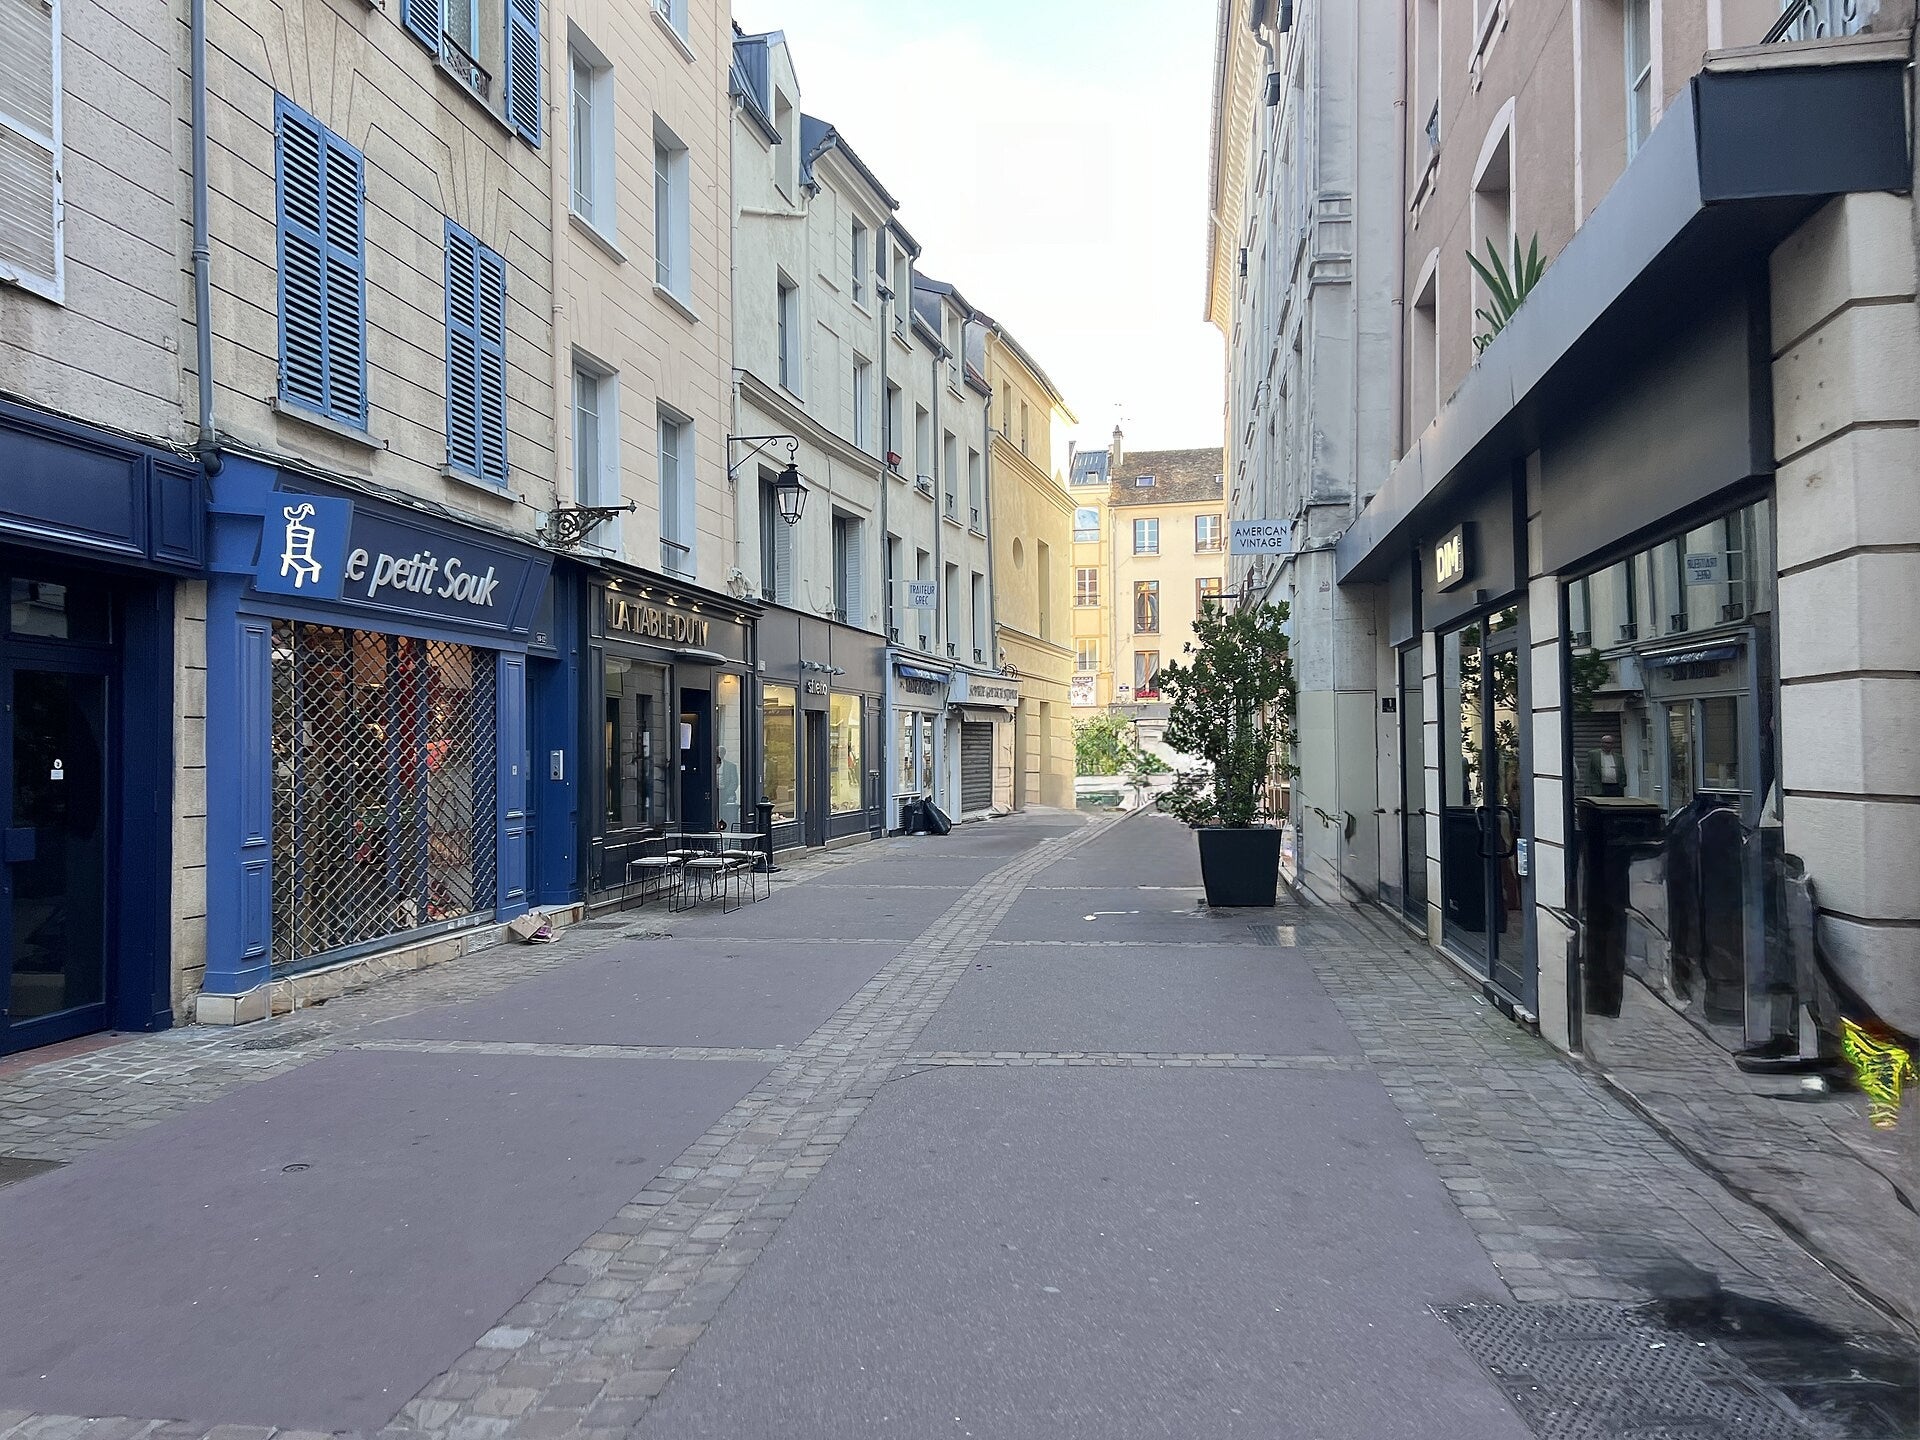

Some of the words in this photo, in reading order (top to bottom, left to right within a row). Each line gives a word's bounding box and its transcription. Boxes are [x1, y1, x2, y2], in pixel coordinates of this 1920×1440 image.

[1235, 526, 1288, 537] AMERICAN
[1240, 537, 1282, 548] VINTAGE
[1436, 535, 1459, 583] DIM
[345, 548, 369, 581] e
[367, 550, 439, 598] petit
[437, 557, 500, 607] Souk
[910, 584, 935, 595] TRAITEUR
[915, 595, 929, 605] GREC
[608, 597, 631, 632] LA
[631, 603, 673, 640] TABLE
